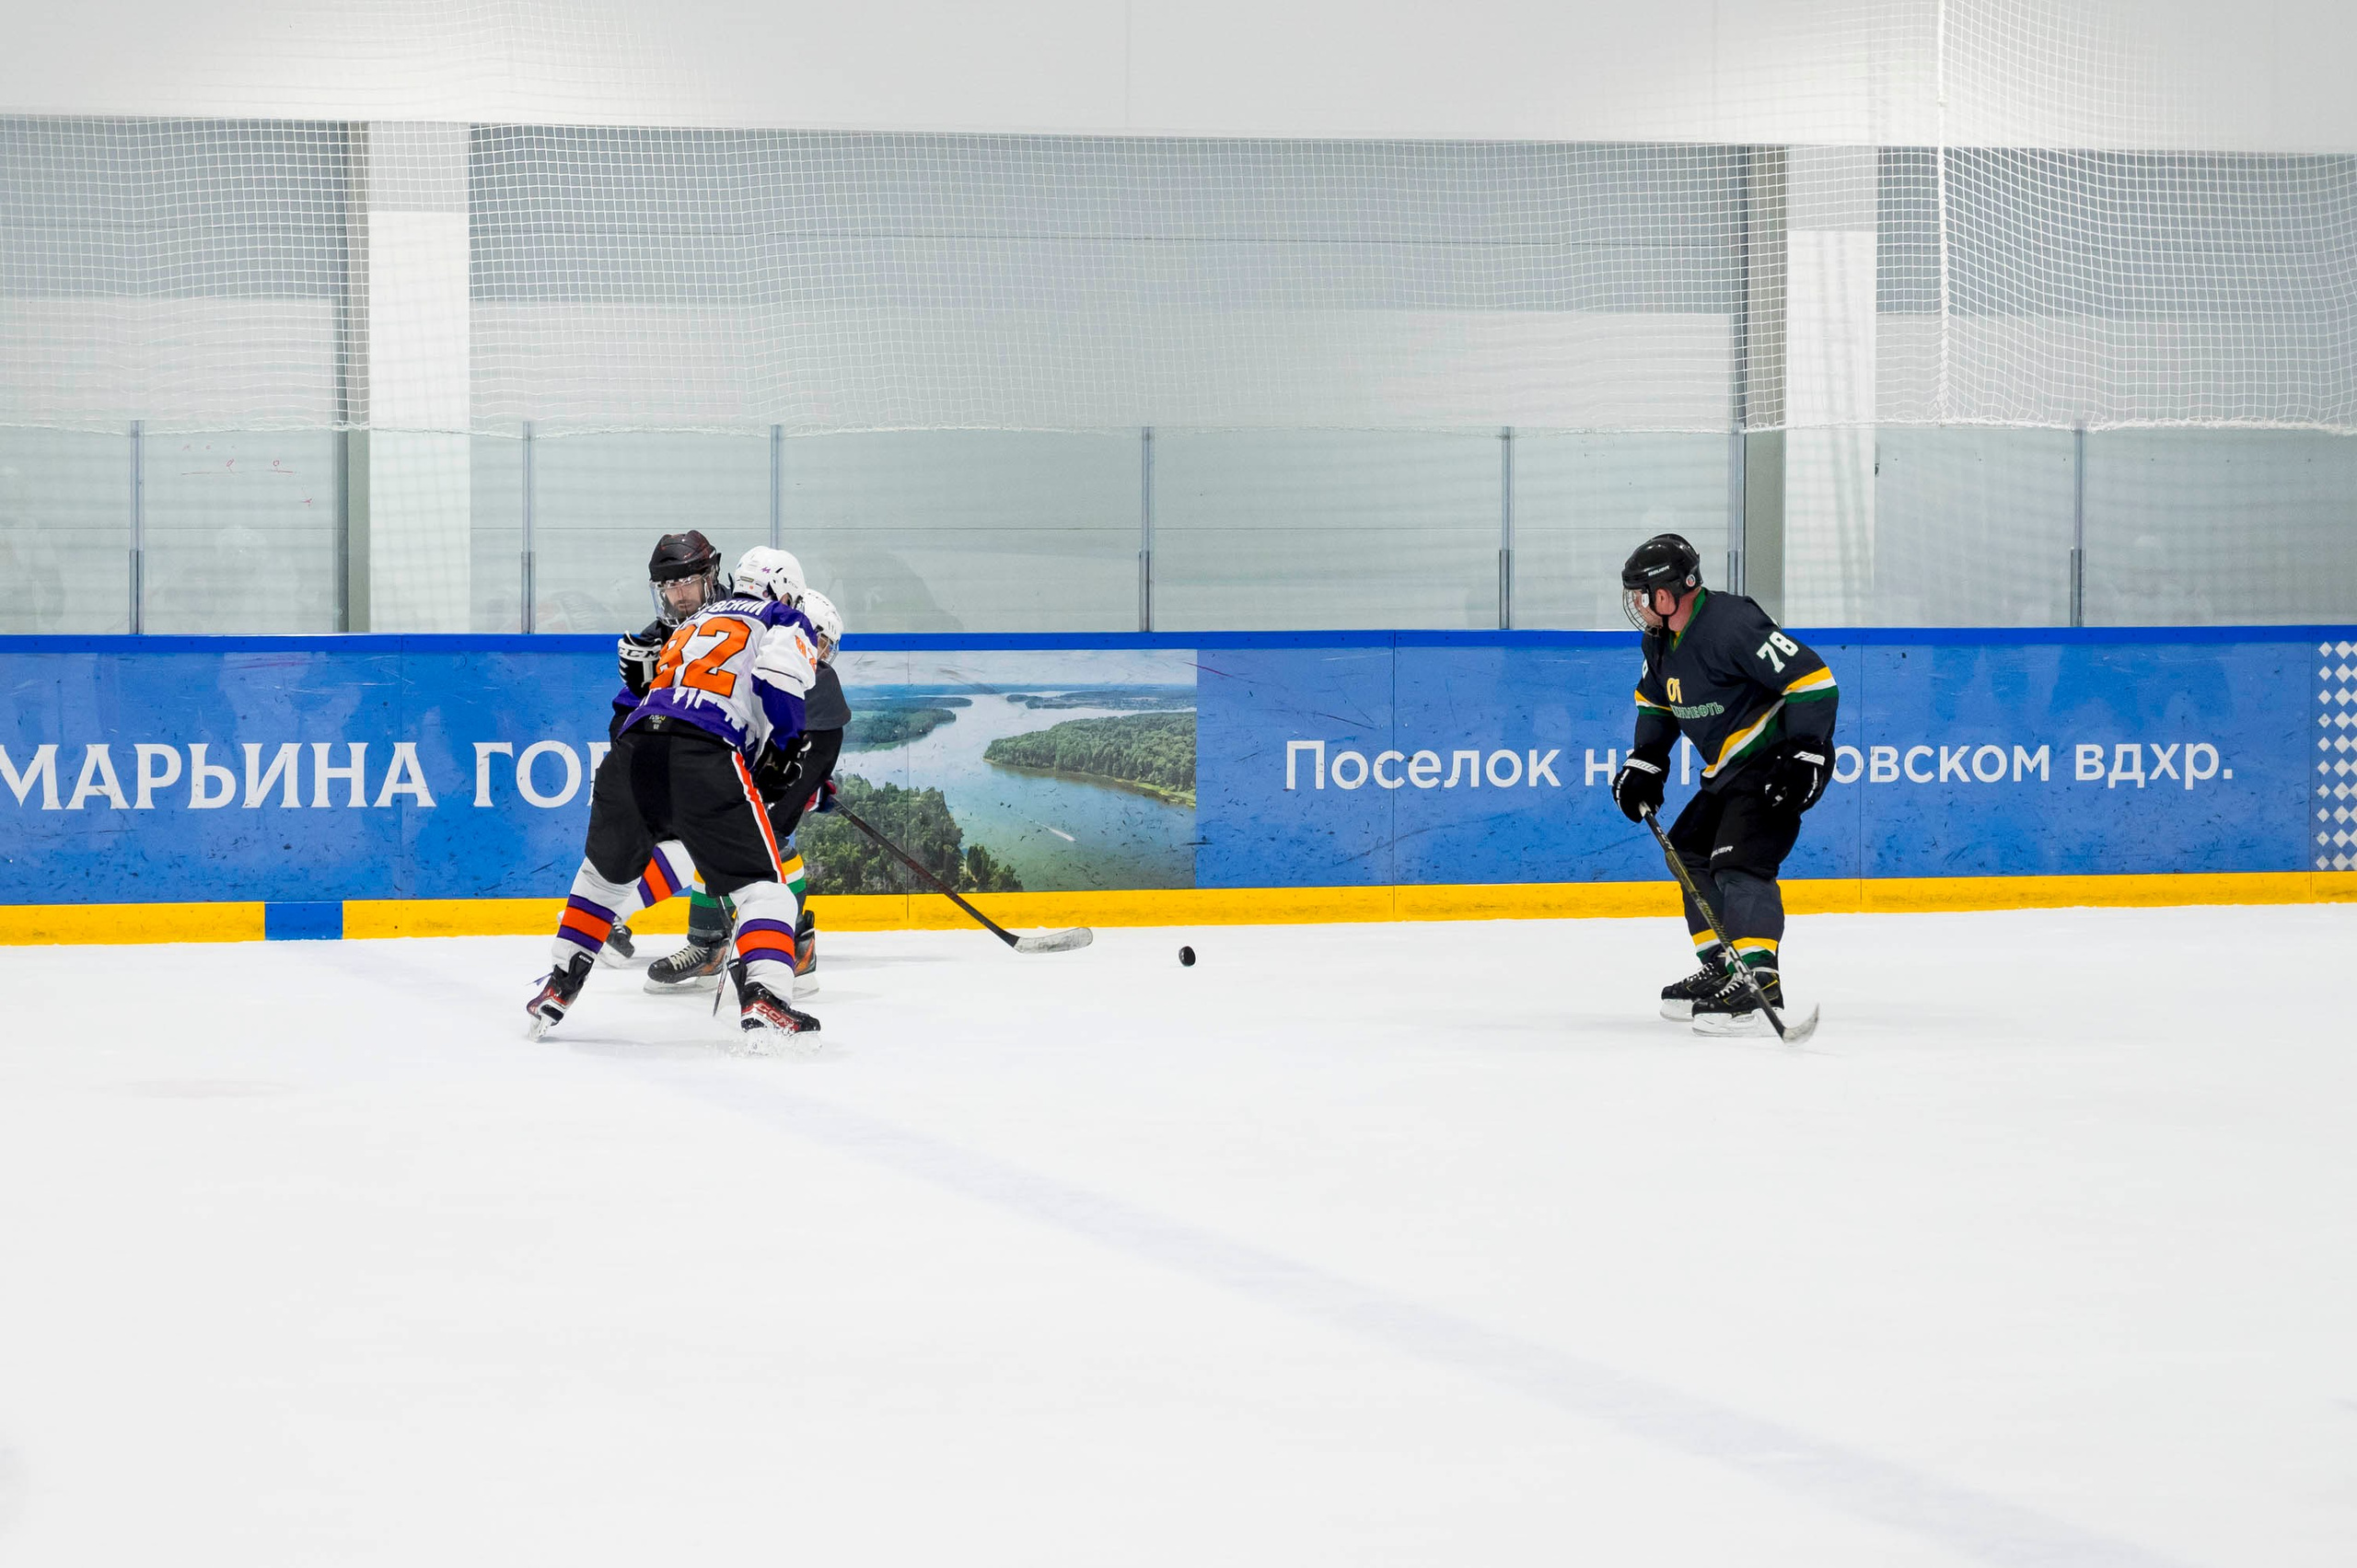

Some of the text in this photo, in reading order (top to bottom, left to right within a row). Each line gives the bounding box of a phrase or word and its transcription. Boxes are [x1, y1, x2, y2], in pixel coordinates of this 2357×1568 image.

[648, 615, 752, 697] 82
[1756, 631, 1799, 673] 78
[0, 742, 436, 810] МАРЬИНА
[1286, 737, 2234, 791] Поселок н овском вдхр.
